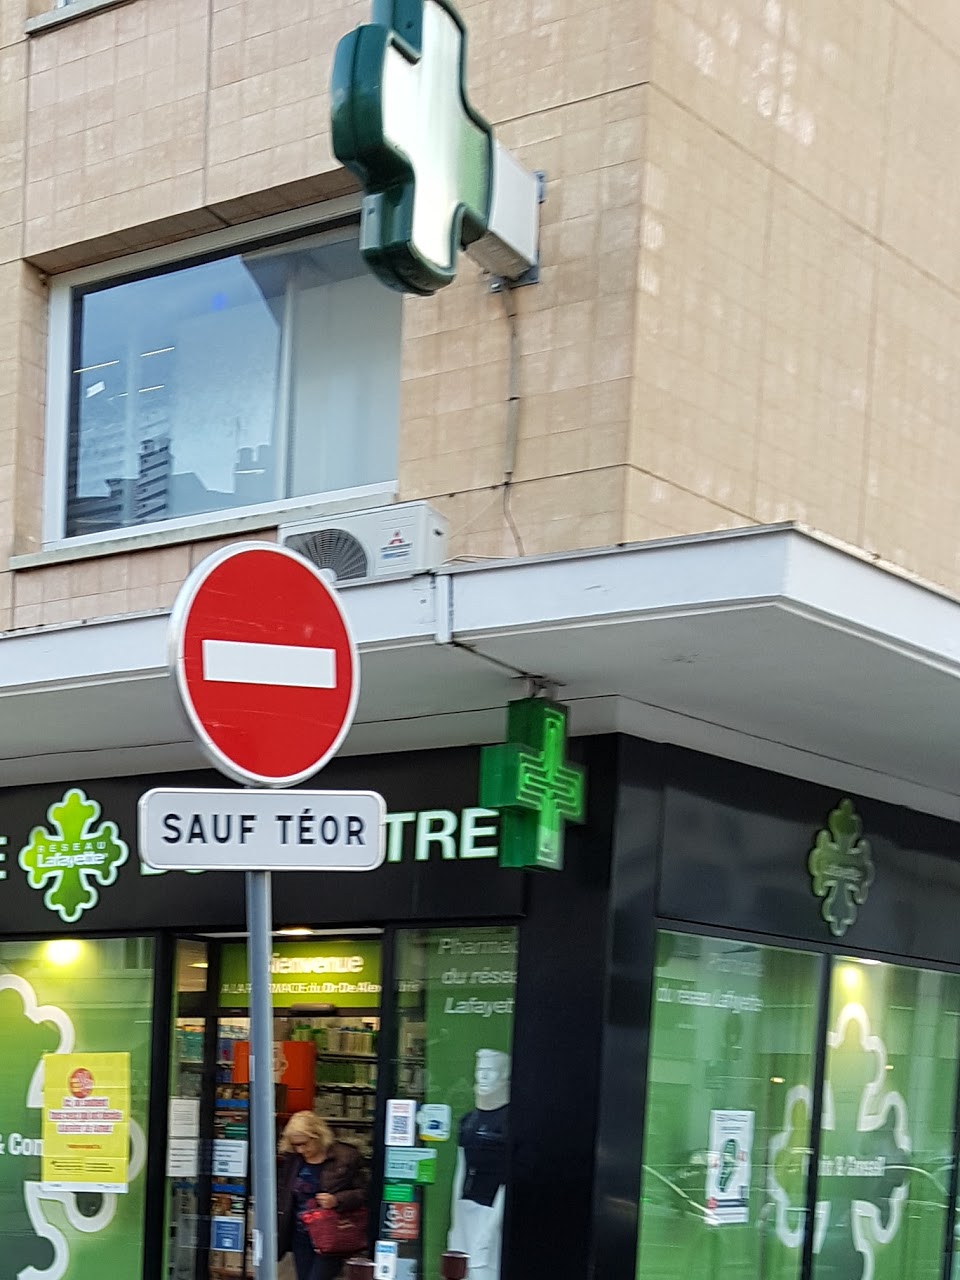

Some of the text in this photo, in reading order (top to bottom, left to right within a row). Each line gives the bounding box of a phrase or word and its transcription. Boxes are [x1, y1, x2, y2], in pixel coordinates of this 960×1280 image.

[161, 808, 367, 846] SAUF TÉOR
[385, 807, 500, 863] TRE
[36, 851, 108, 868] Lafayette
[269, 952, 365, 974] ienvenue
